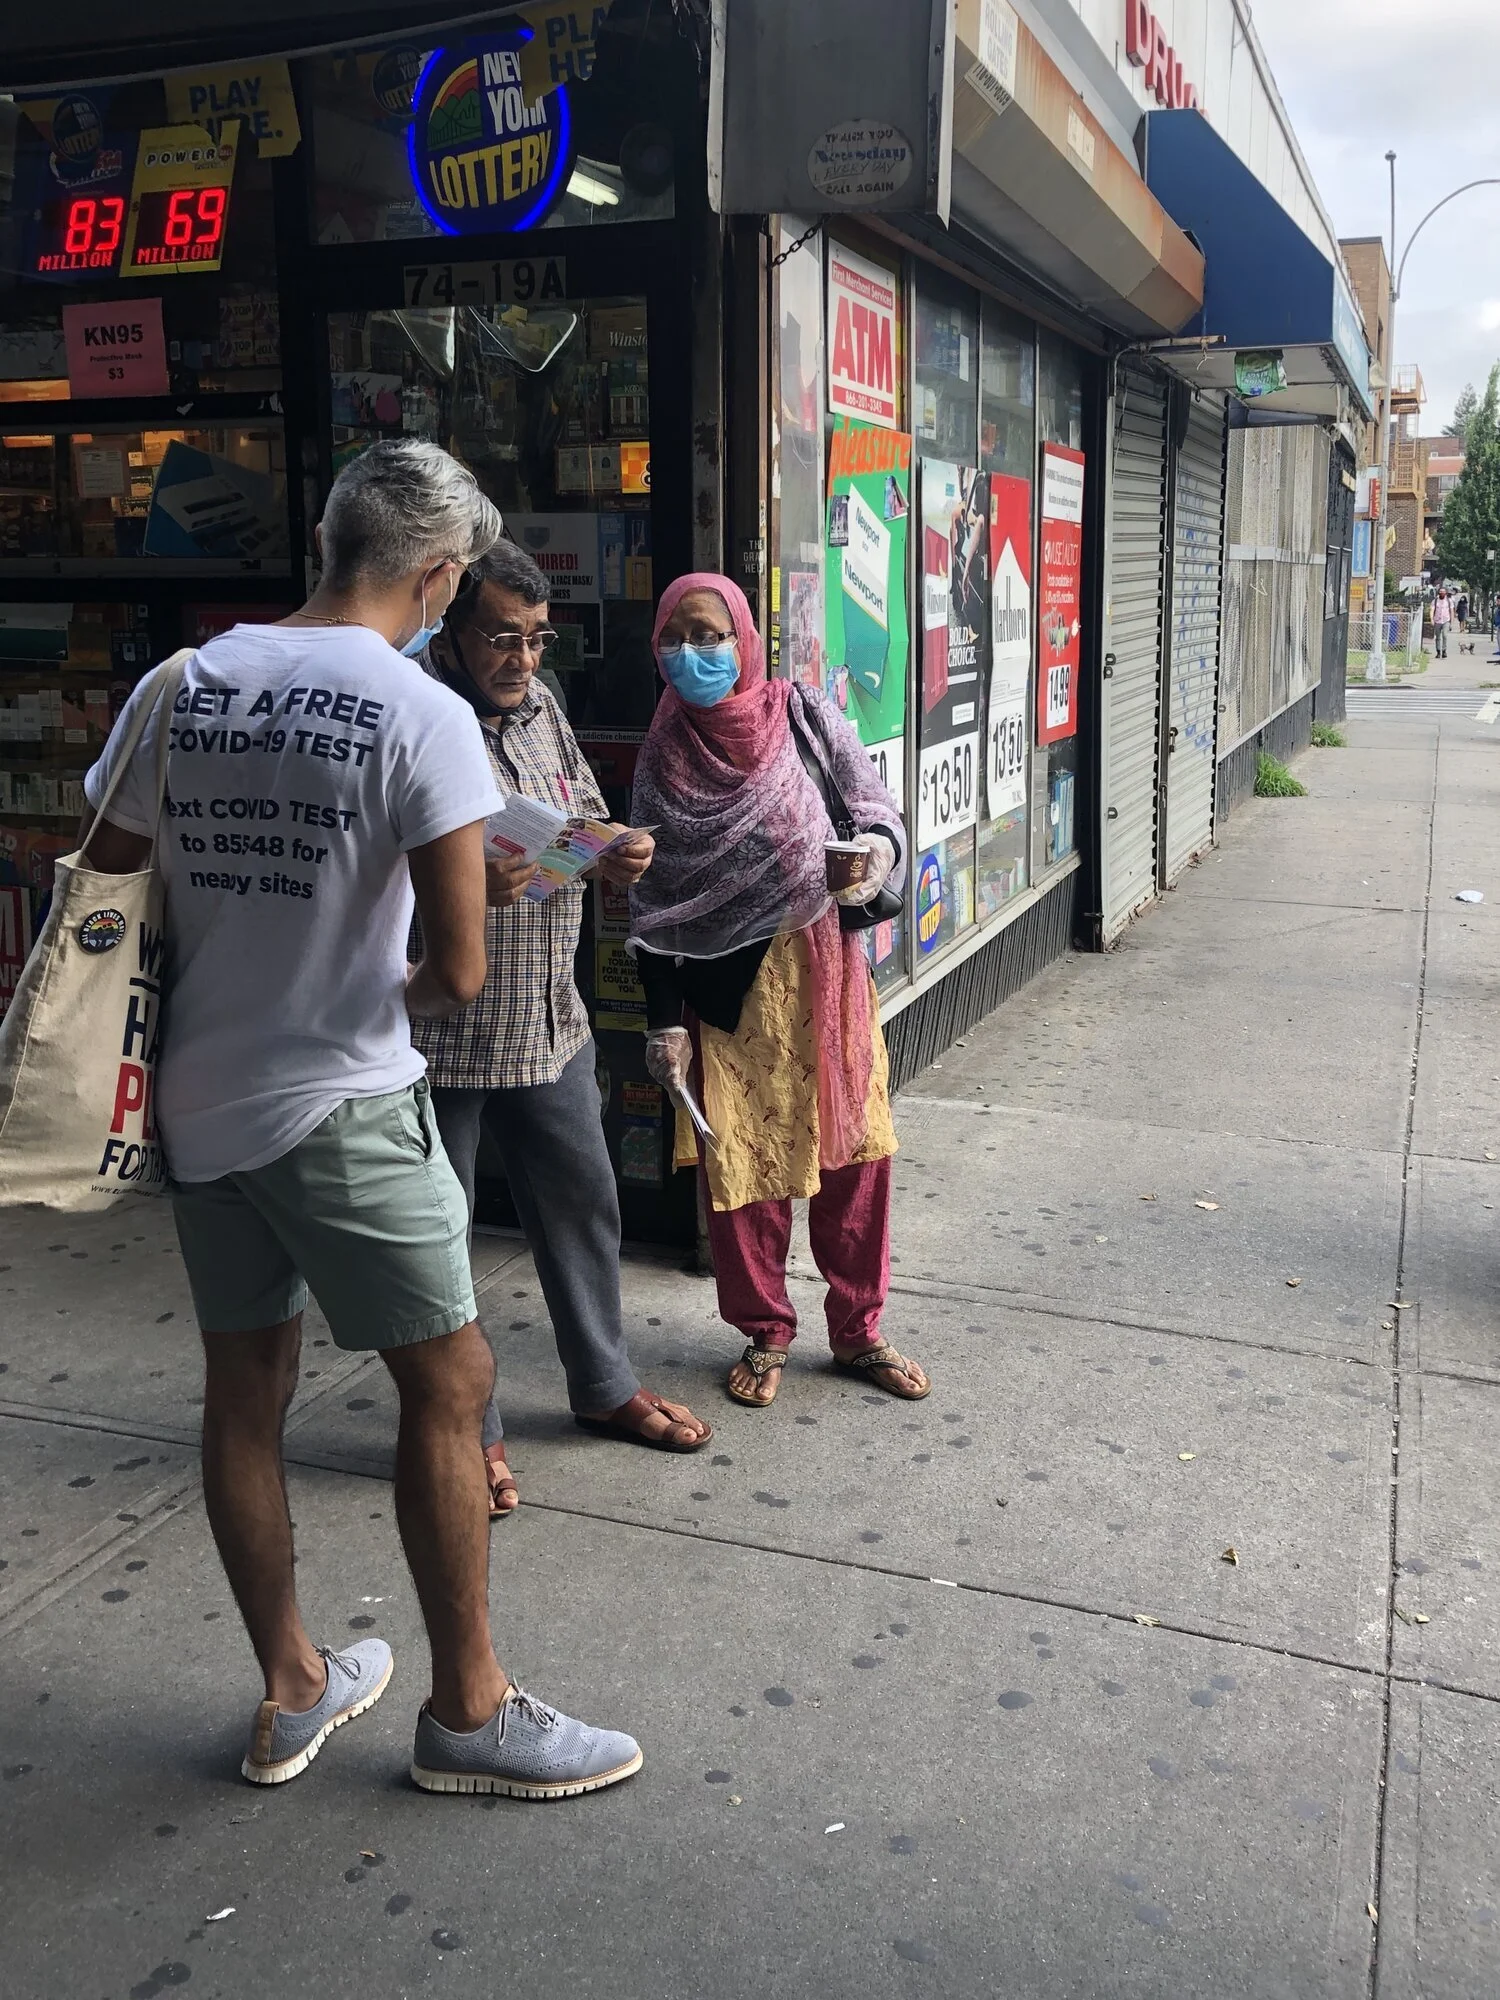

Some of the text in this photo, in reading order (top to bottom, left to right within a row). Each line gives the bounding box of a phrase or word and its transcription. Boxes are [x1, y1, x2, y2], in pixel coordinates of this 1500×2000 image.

[189, 76, 261, 113] PLAY
[868, 129, 893, 139] YOU
[146, 148, 216, 165] POWER
[429, 129, 552, 209] LOTTERY
[857, 181, 894, 193] AGAIN
[66, 197, 124, 252] 83
[165, 188, 226, 245] 69
[38, 252, 113, 271] MILLION
[137, 243, 215, 264] MILLION
[405, 260, 564, 306] 74-19A
[84, 323, 144, 346] KN95
[832, 295, 893, 394] ATM
[108, 367, 125, 380] $3
[855, 506, 880, 548] Newport
[536, 554, 578, 570] UIRED!
[551, 589, 571, 599] INESS
[844, 559, 884, 612] Newport
[993, 575, 1026, 643] Marlboro
[947, 646, 976, 667] CHOICE.
[173, 686, 384, 731] GET A FREE
[169, 727, 374, 767] COVID-19 TEST
[582, 732, 613, 741] addictive
[165, 796, 358, 832] ext COVID TEST
[180, 833, 207, 852] to
[292, 838, 328, 864] for
[259, 872, 314, 900] sites
[608, 958, 640, 967] TOBACC
[98, 1138, 148, 1181] FOR
